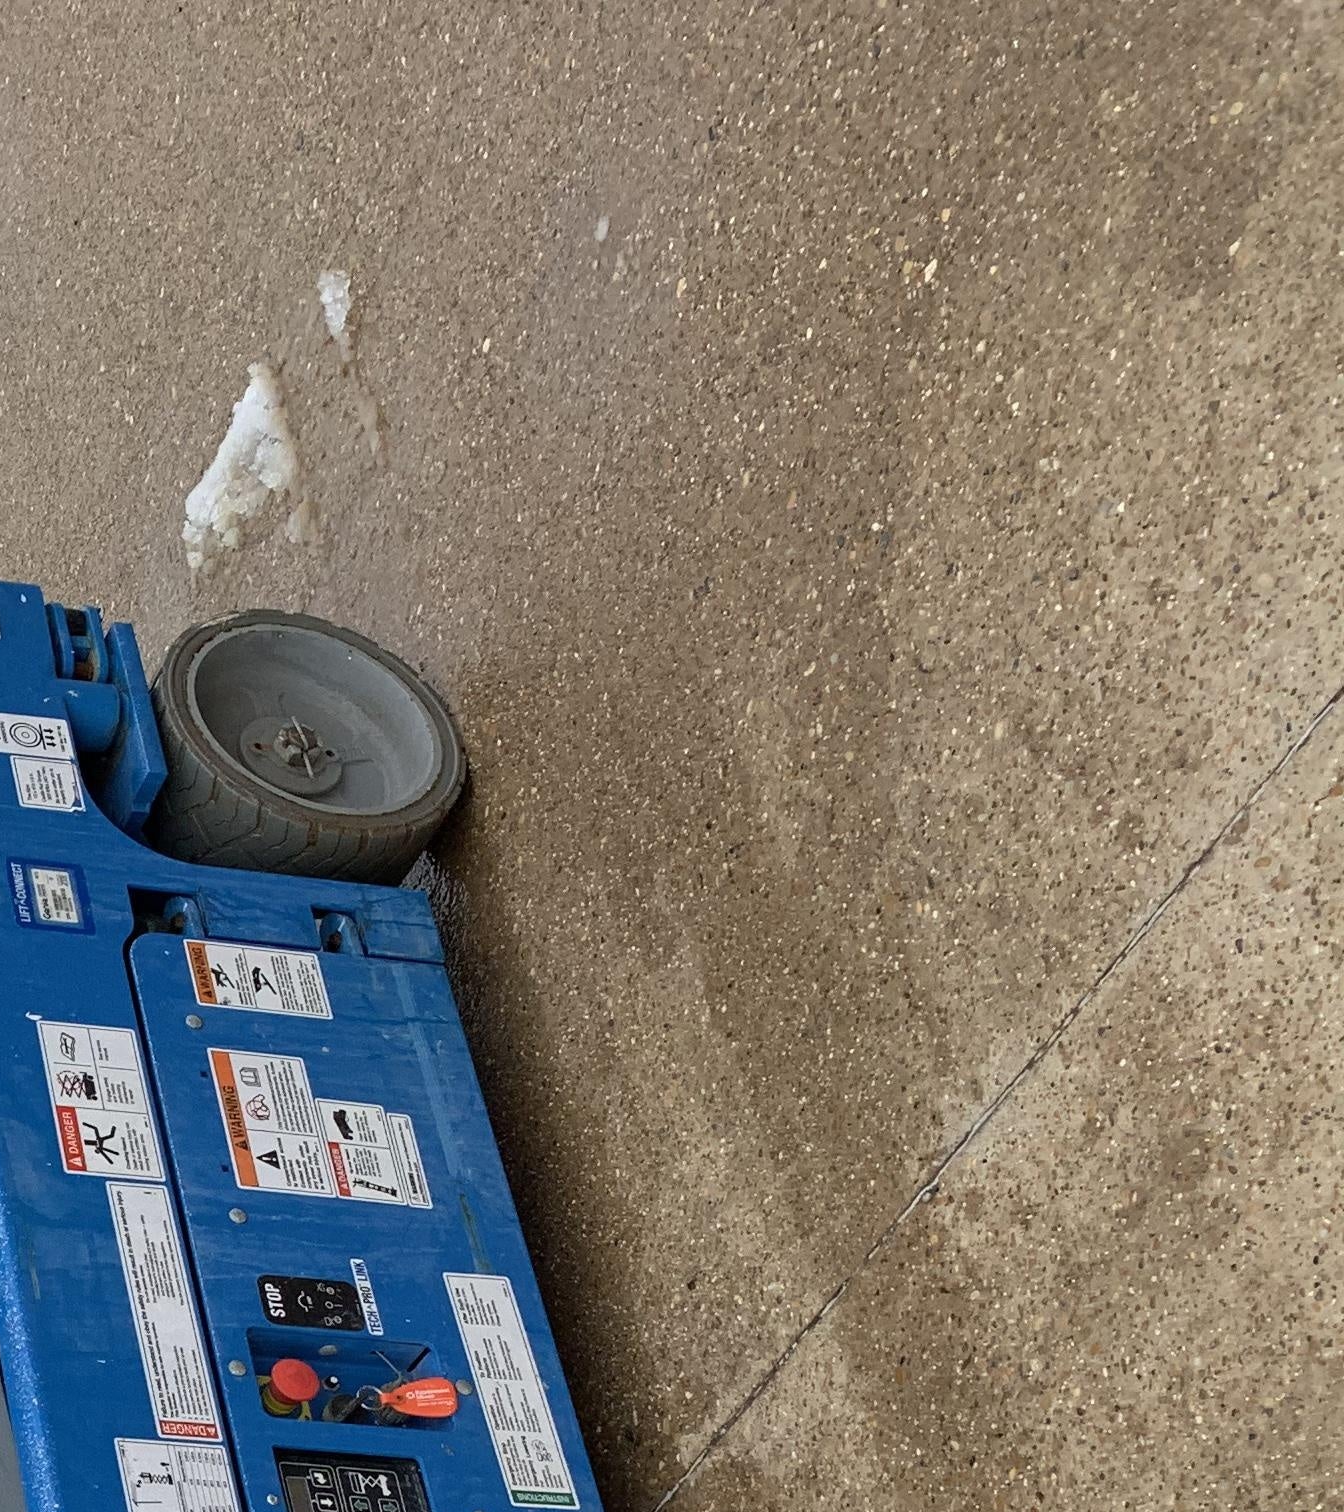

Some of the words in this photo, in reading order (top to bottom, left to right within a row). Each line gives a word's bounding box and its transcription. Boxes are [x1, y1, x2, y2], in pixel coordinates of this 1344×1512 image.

[10, 862, 26, 900] CONNECT
[18, 905, 31, 923] LIFT
[191, 947, 210, 988] WARNING
[221, 1085, 245, 1139] WARNING
[61, 1112, 79, 1155] DANGER
[352, 1262, 369, 1282] LINK
[264, 1283, 286, 1318] STOP
[365, 1311, 381, 1333] TECH
[161, 1422, 207, 1433] DANGER
[515, 1493, 571, 1504] INSTRUCTIONS
